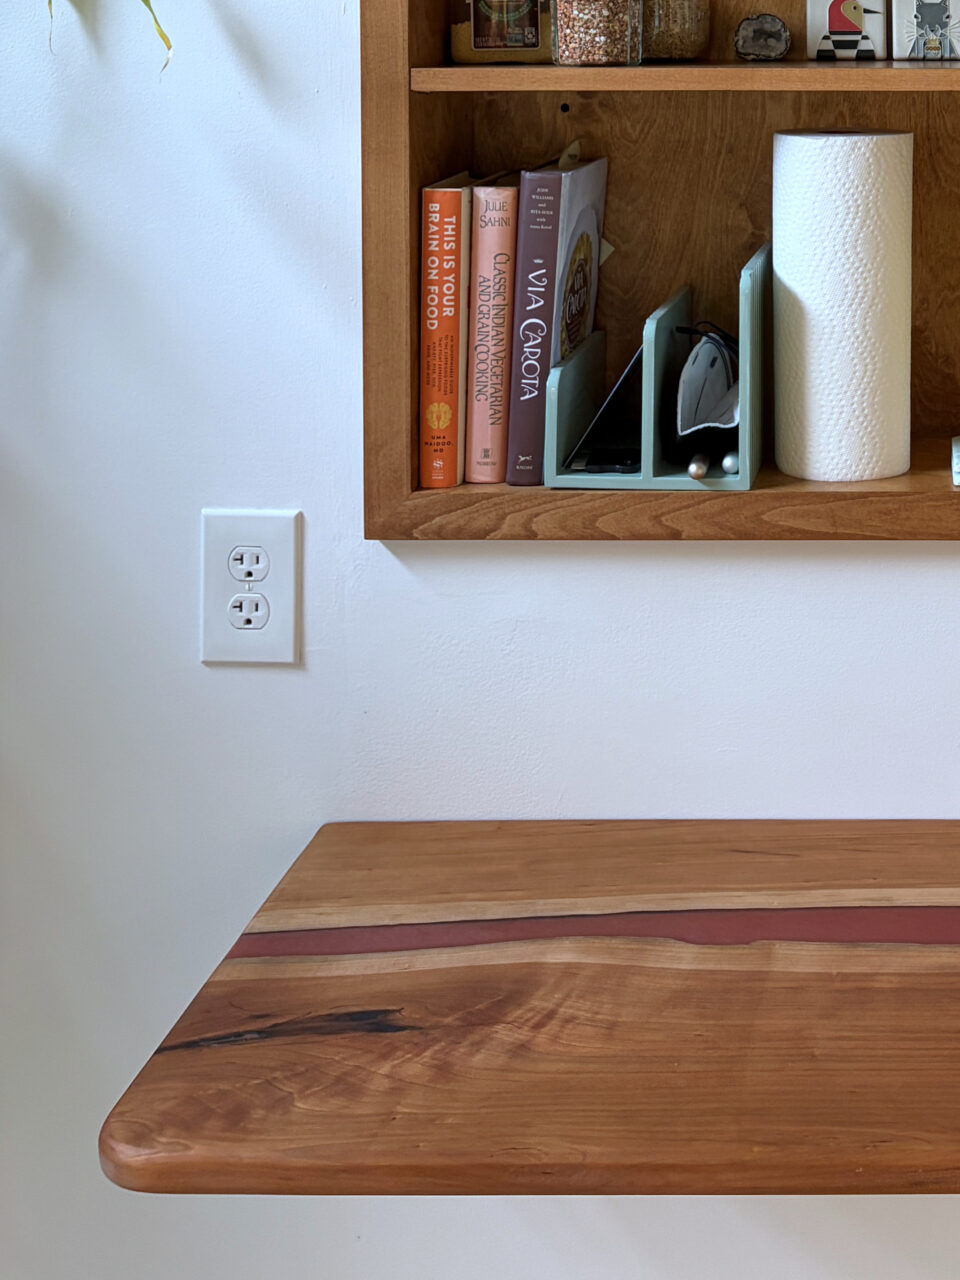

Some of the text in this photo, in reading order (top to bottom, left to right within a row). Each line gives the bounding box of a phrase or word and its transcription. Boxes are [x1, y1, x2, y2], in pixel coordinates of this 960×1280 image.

[428, 203, 440, 251] BRAIN
[480, 215, 510, 228] SAHNI
[484, 200, 508, 214] JULIE
[428, 256, 439, 280] ON
[442, 216, 456, 317] THIS IS YOUR
[426, 286, 438, 330] FOOD
[474, 275, 490, 402] AND GRAIN COOKING
[488, 252, 510, 426] CLASSIC INDIAN VEGETARIAN
[520, 268, 548, 401] VIA CAROTA
